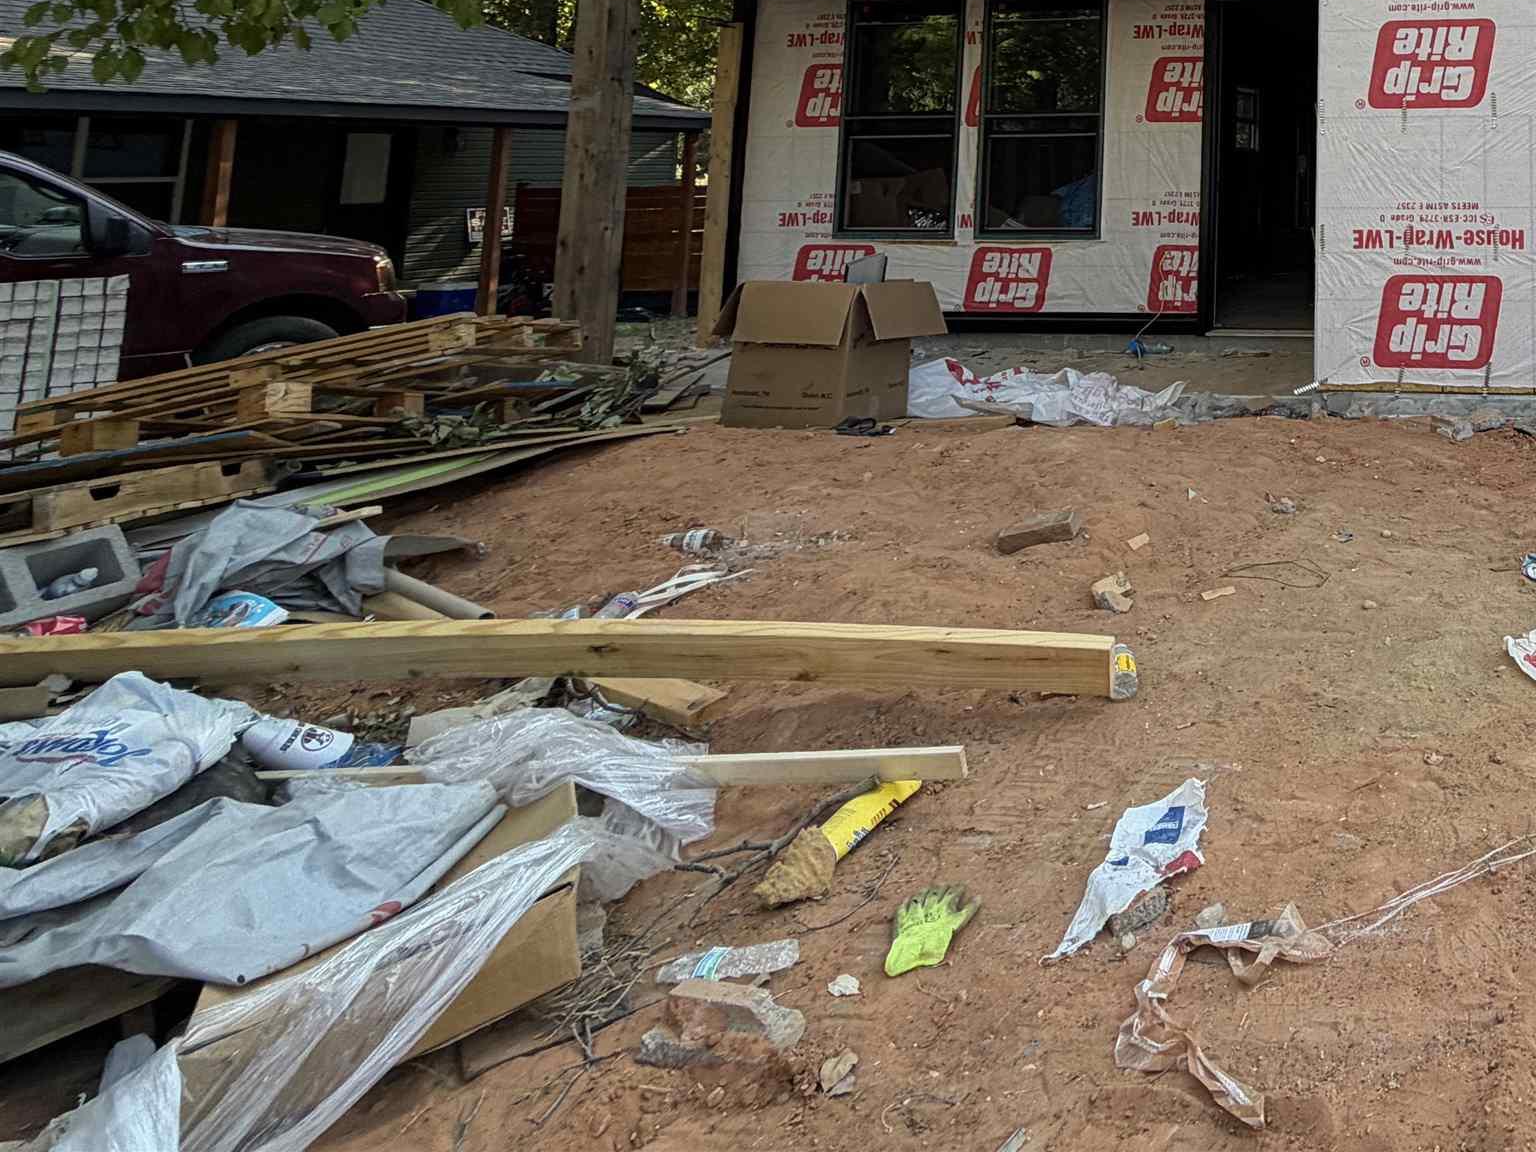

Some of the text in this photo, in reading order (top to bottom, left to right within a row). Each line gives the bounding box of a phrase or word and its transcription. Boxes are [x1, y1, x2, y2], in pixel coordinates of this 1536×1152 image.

[1388, 2, 1475, 12] www.grip-rite.com
[1392, 26, 1480, 62] Rite
[1163, 62, 1202, 87] ite
[1384, 60, 1475, 101] Grip
[806, 92, 841, 121] rip
[1156, 86, 1202, 116] rip
[1396, 202, 1416, 210] 2357
[1425, 202, 1449, 210] ASTM
[1451, 202, 1479, 210] MEETS
[1352, 226, 1524, 250] House-Wrap-LWE
[982, 252, 1042, 278] Rite
[1161, 250, 1198, 276] ite
[1393, 256, 1481, 266] www.grip-rite.com
[974, 276, 1039, 308] Grip
[1158, 274, 1198, 306] rip
[1398, 282, 1486, 320] Rite
[1388, 317, 1482, 362] Grip
